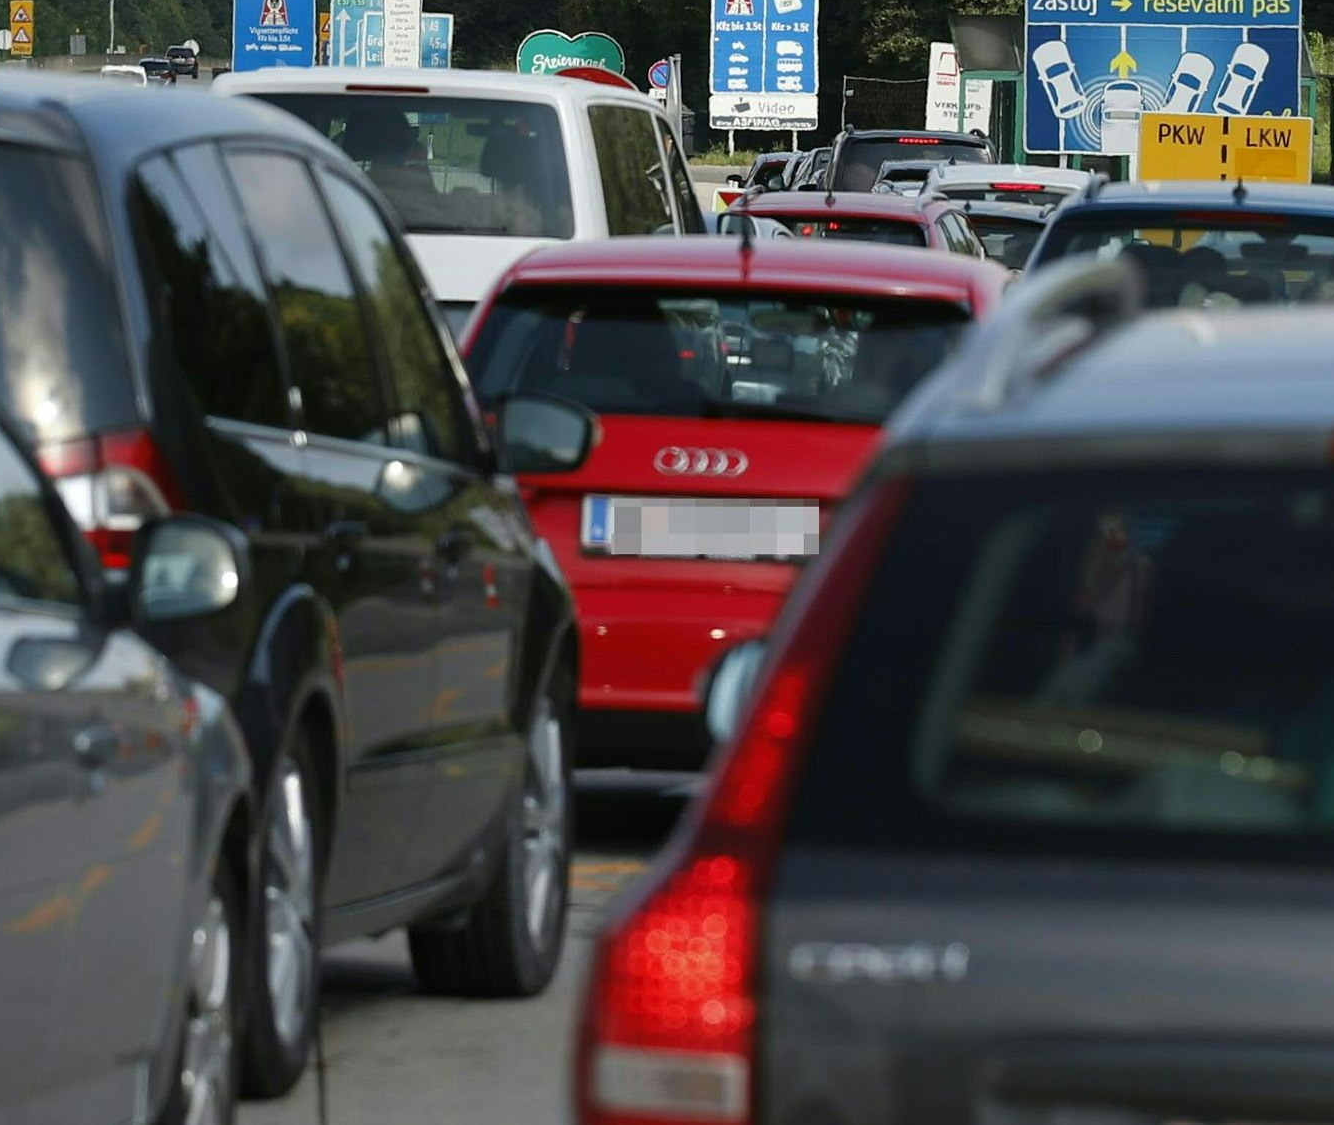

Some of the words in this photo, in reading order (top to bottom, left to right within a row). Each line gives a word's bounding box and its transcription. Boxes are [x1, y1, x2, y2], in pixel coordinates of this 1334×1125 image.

[716, 21, 730, 31] Kfz
[732, 21, 744, 31] bis
[367, 35, 383, 47] Gra
[758, 102, 795, 115] Video
[1158, 123, 1205, 145] PKW
[1246, 127, 1292, 148] LKW
